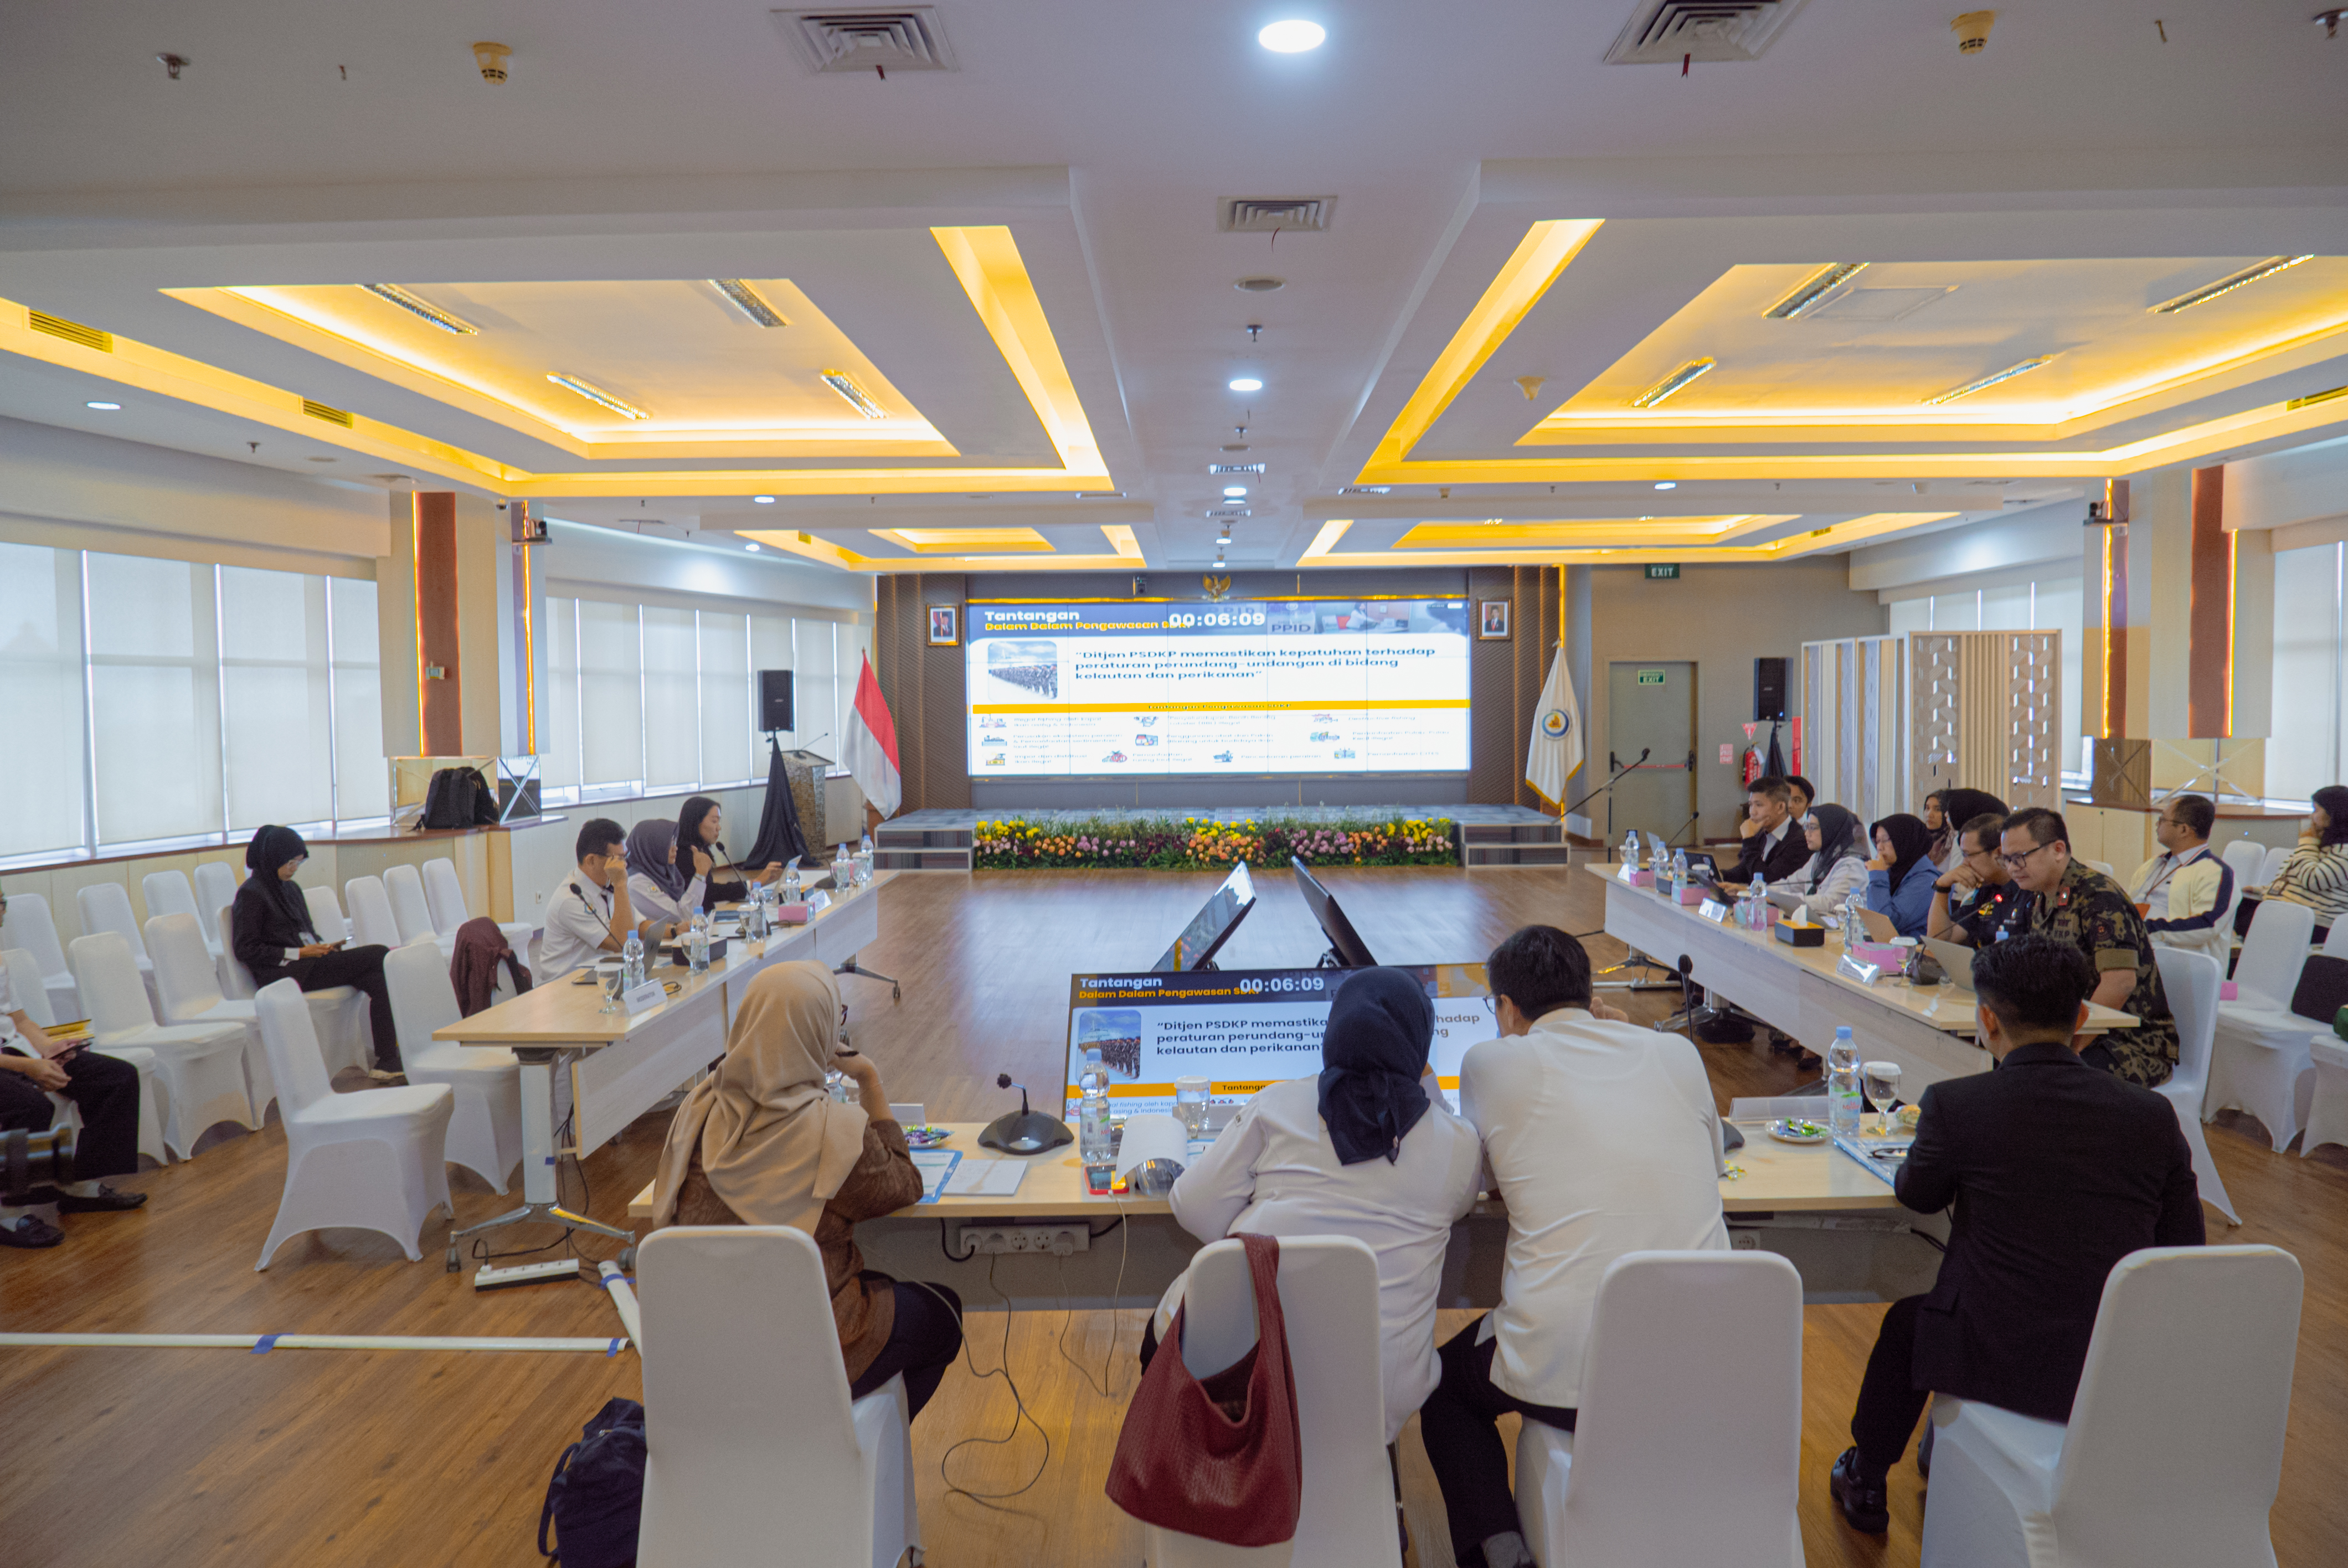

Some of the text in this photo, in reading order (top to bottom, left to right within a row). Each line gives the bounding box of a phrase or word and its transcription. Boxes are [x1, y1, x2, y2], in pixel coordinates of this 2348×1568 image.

[1651, 567, 1673, 577] EXIT
[985, 611, 1079, 622] Tantangan
[1169, 613, 1265, 627] 00:06:09
[1075, 622, 1158, 631] Pengawasan
[1280, 649, 1361, 659] kepatuhan
[1366, 648, 1435, 658] terhadap
[1076, 662, 1150, 671] peraturan
[1155, 659, 1324, 670] perundang-undangan
[1346, 658, 1398, 668] bidang
[1080, 978, 1162, 989] Tantangan
[1240, 978, 1324, 992] 00:06:09
[1079, 990, 1116, 998] Dalam
[1119, 989, 1156, 998] Dalam
[1158, 988, 1231, 998] Pengawasan
[1206, 1020, 1248, 1029] PSDKP
[1252, 1018, 1327, 1027] memastika
[1157, 1034, 1225, 1044] peraturan
